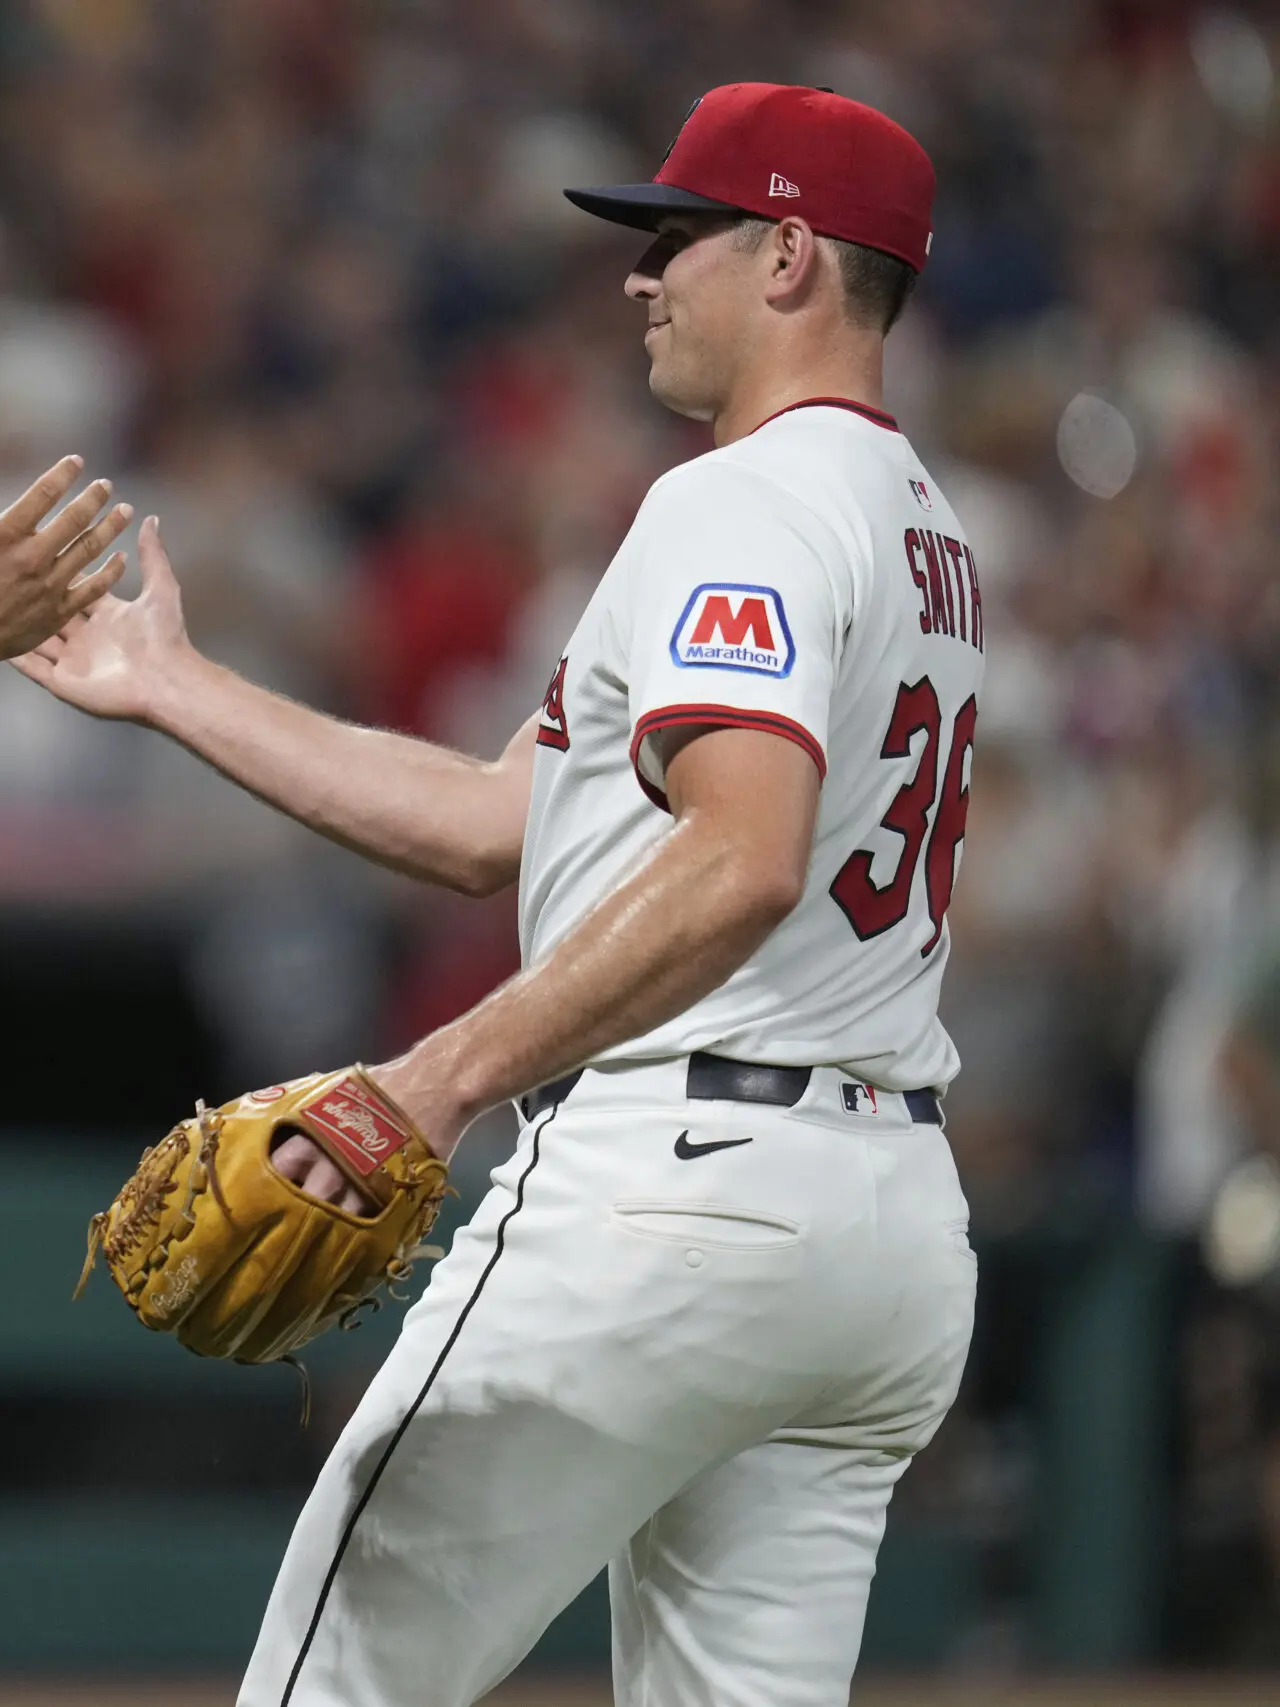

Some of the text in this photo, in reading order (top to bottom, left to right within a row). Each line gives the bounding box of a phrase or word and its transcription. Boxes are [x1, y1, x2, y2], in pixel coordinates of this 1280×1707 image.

[903, 527, 984, 655] SMITH
[688, 595, 776, 652] M
[684, 645, 780, 667] Marathon
